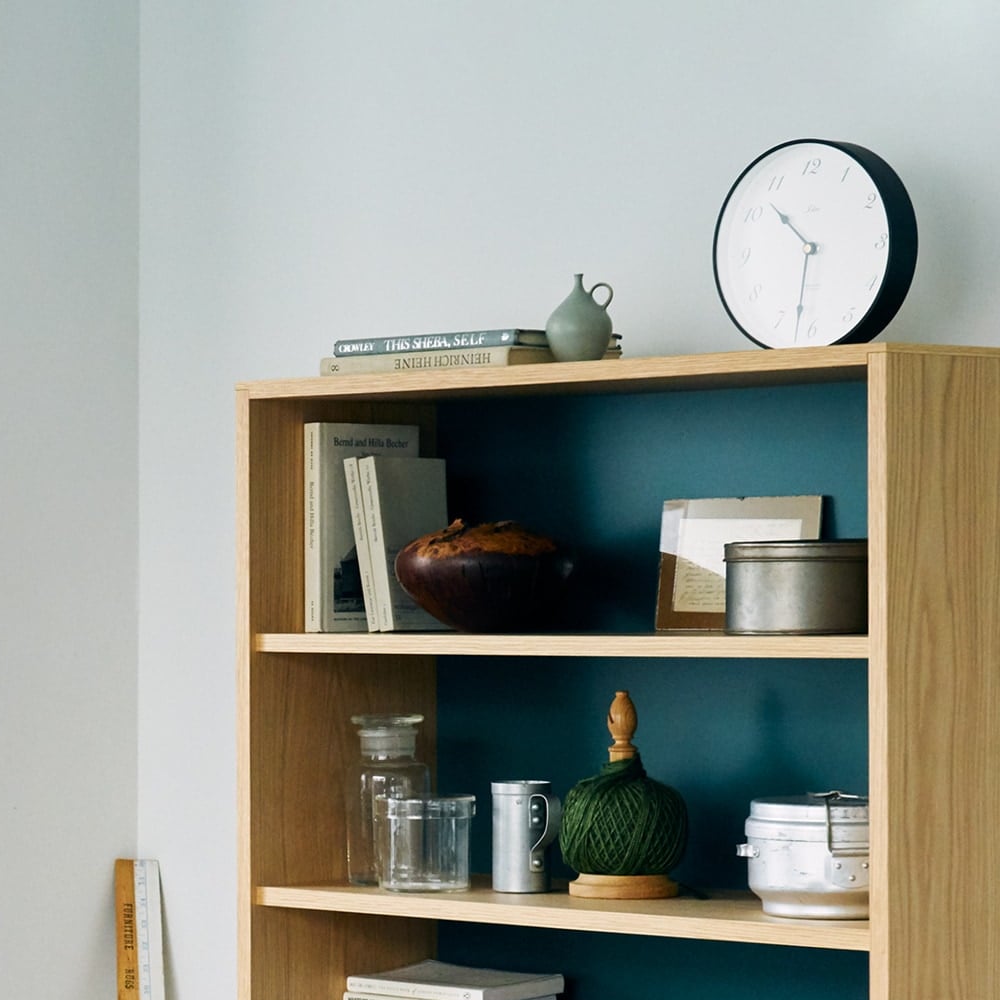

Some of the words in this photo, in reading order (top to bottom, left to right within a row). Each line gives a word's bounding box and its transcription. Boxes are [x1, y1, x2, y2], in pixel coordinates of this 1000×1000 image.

[802, 159, 821, 176] 12
[841, 167, 850, 182] 1
[768, 176, 784, 191] 11
[864, 193, 877, 209] 2
[744, 207, 763, 223] 10
[875, 232, 888, 250] 3
[807, 319, 817, 338] 6
[338, 343, 375, 353] CROWLEY
[384, 338, 410, 351] THIS
[412, 336, 450, 350] SHEBA,
[453, 332, 487, 346] SELF
[395, 357, 432, 370] HEINE
[434, 352, 491, 367] HEINRICH
[333, 437, 354, 447] Bernd
[386, 439, 408, 448] Becher
[124, 903, 134, 950] FURNITURE
